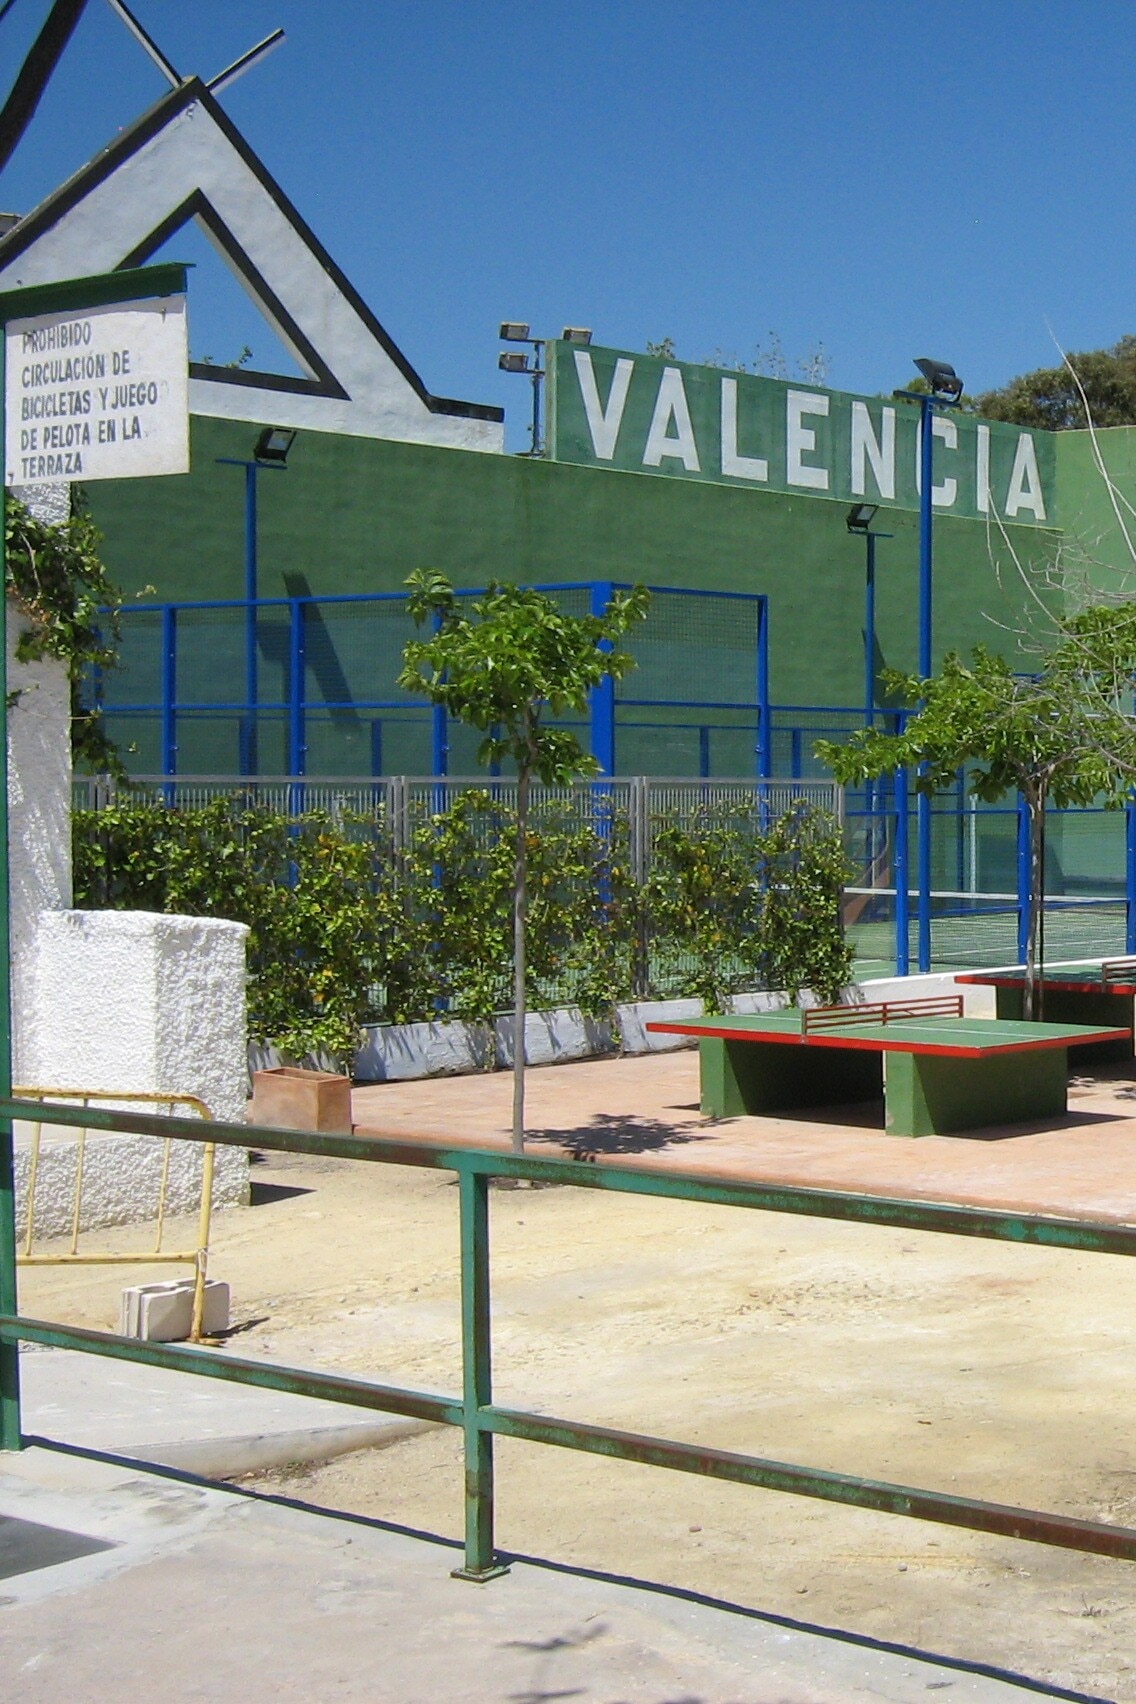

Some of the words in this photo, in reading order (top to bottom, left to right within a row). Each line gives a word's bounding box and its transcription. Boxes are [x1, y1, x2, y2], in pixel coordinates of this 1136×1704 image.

[22, 321, 91, 354] PROHIBIDO
[22, 350, 105, 388] CIRCULACIÓN
[112, 350, 130, 376] DE
[21, 389, 91, 421] BICICLETAS
[99, 387, 108, 410] Y
[111, 382, 157, 410] JUEGO
[21, 429, 38, 451] DE
[43, 422, 91, 449] PELOTA
[98, 418, 116, 443] EN
[122, 415, 142, 440] LA
[573, 350, 1048, 520] VALENCIA
[21, 452, 82, 479] TERRAZA
